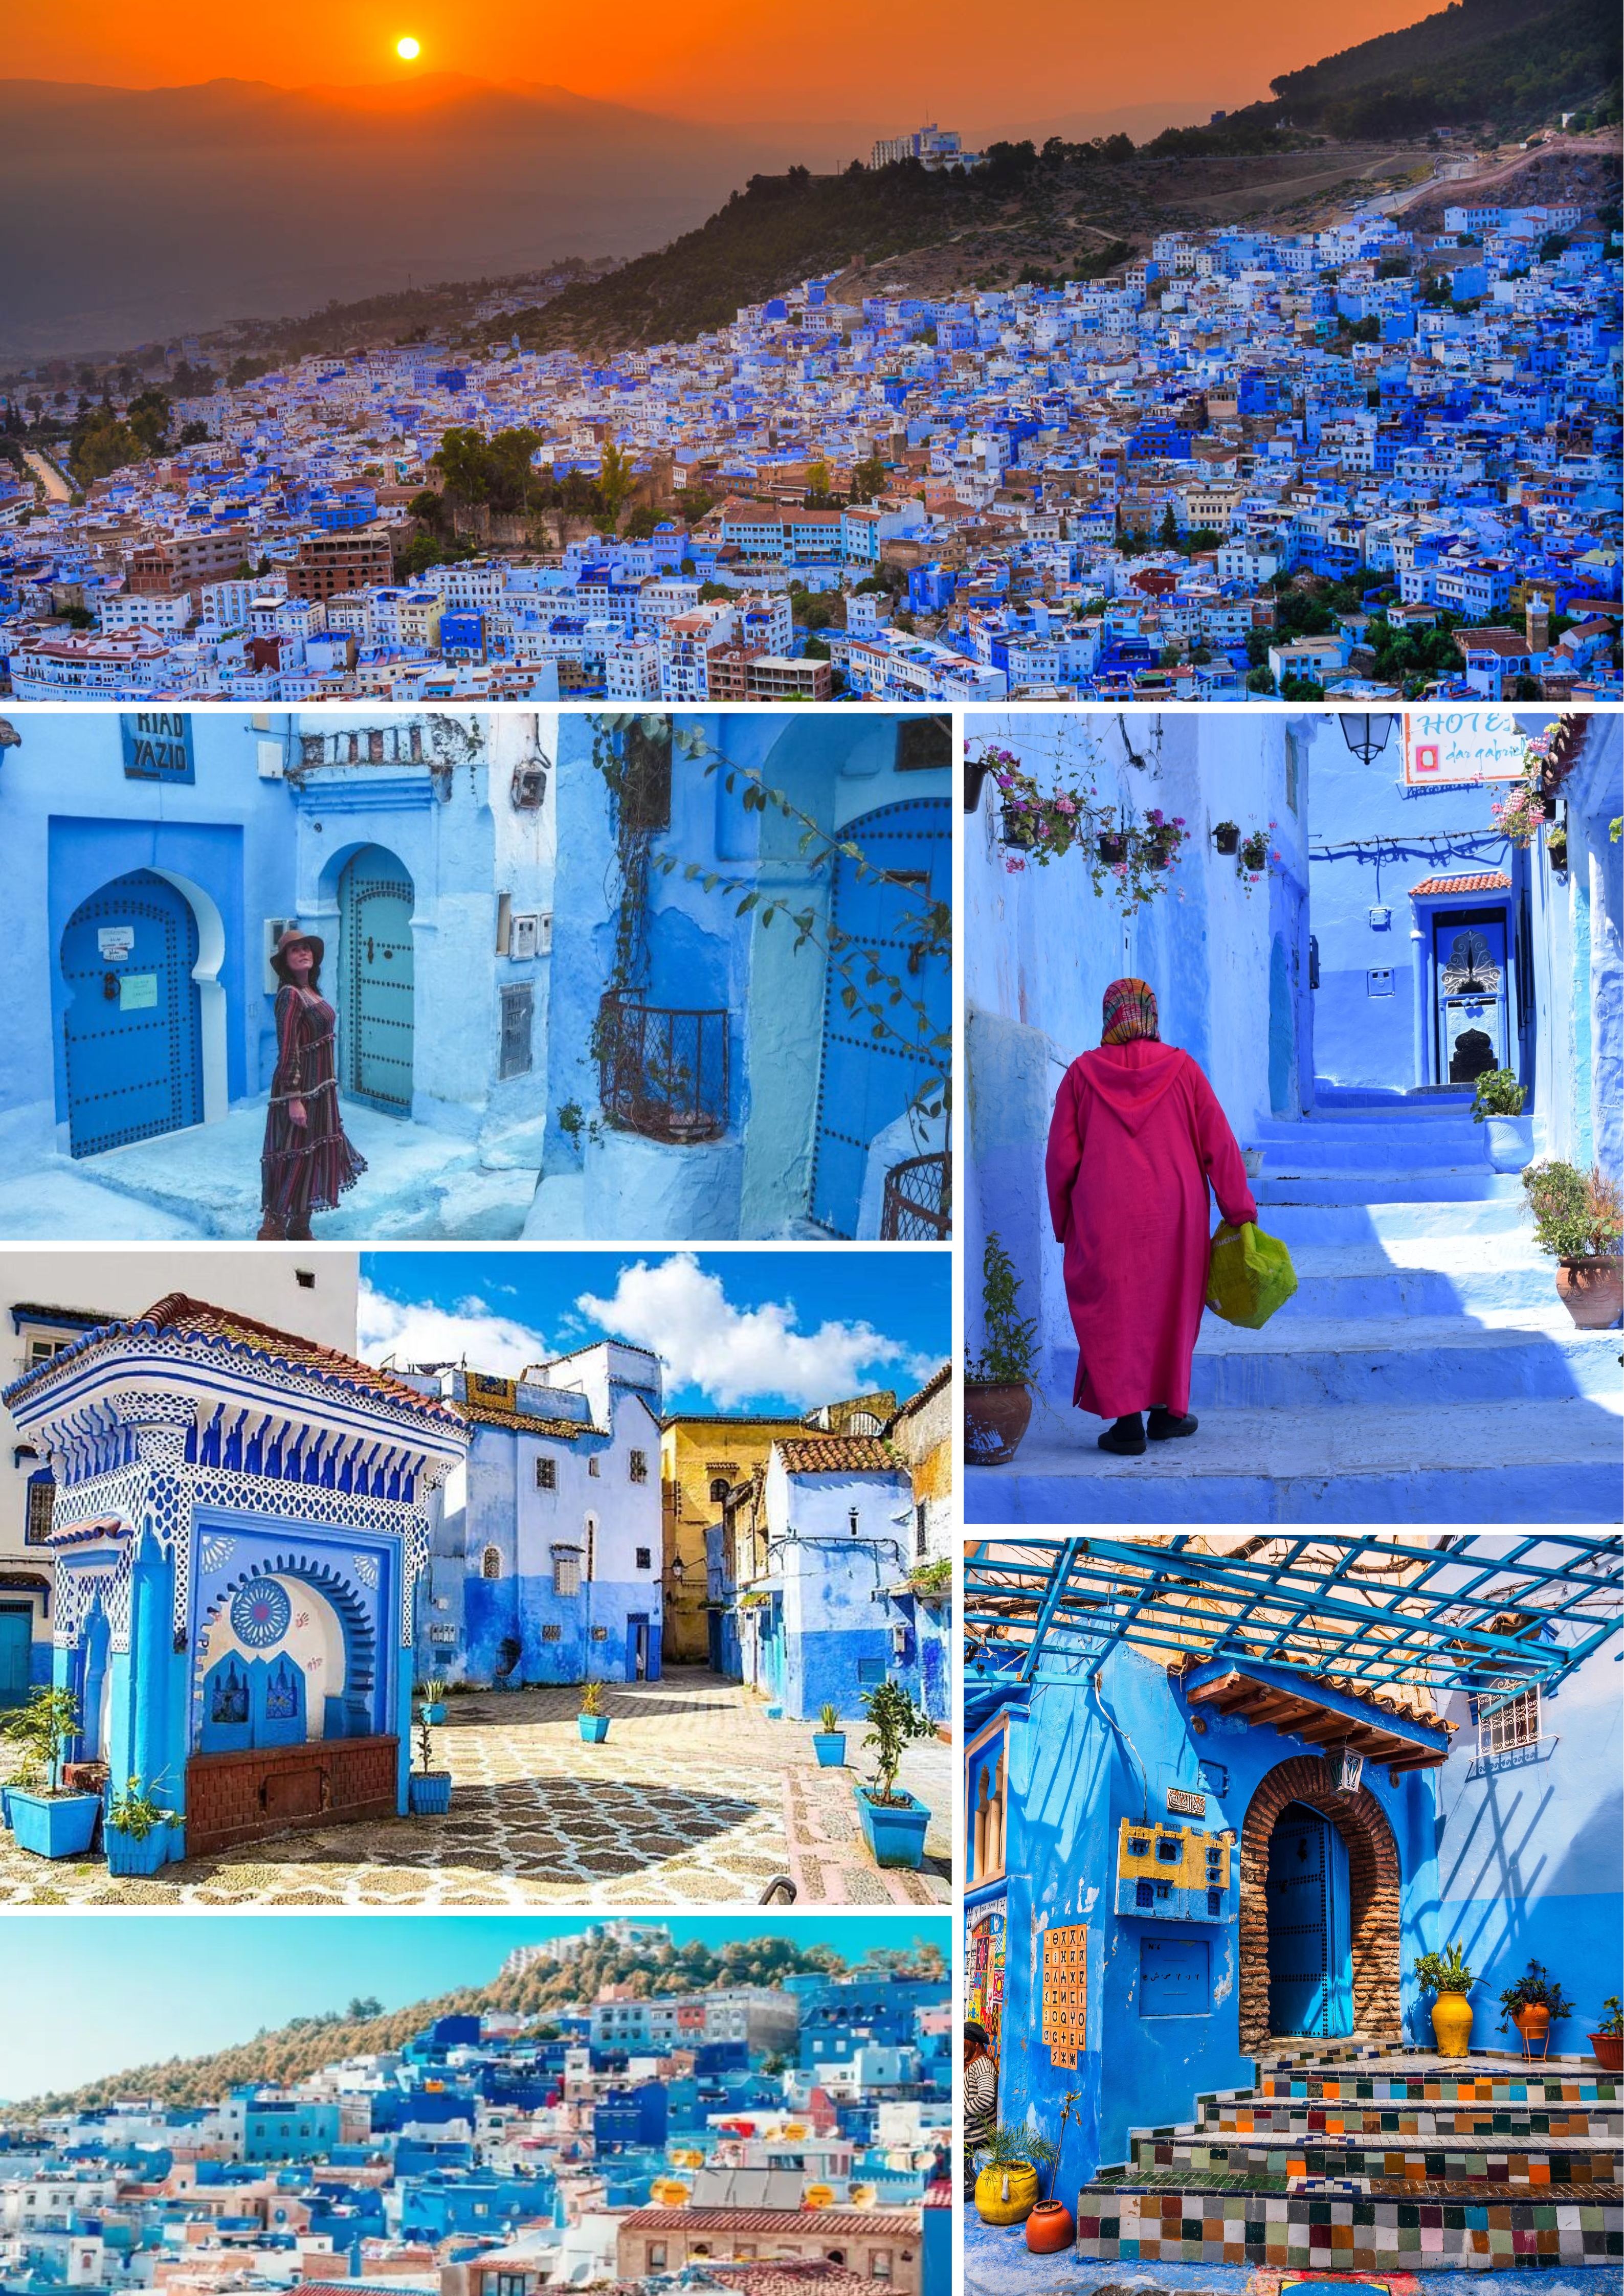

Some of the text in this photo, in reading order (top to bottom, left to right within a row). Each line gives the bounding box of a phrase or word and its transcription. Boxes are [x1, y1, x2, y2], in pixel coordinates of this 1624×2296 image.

[138, 713, 184, 737] RIAD
[133, 738, 187, 770] YAZID
[1446, 740, 1471, 763] dar
